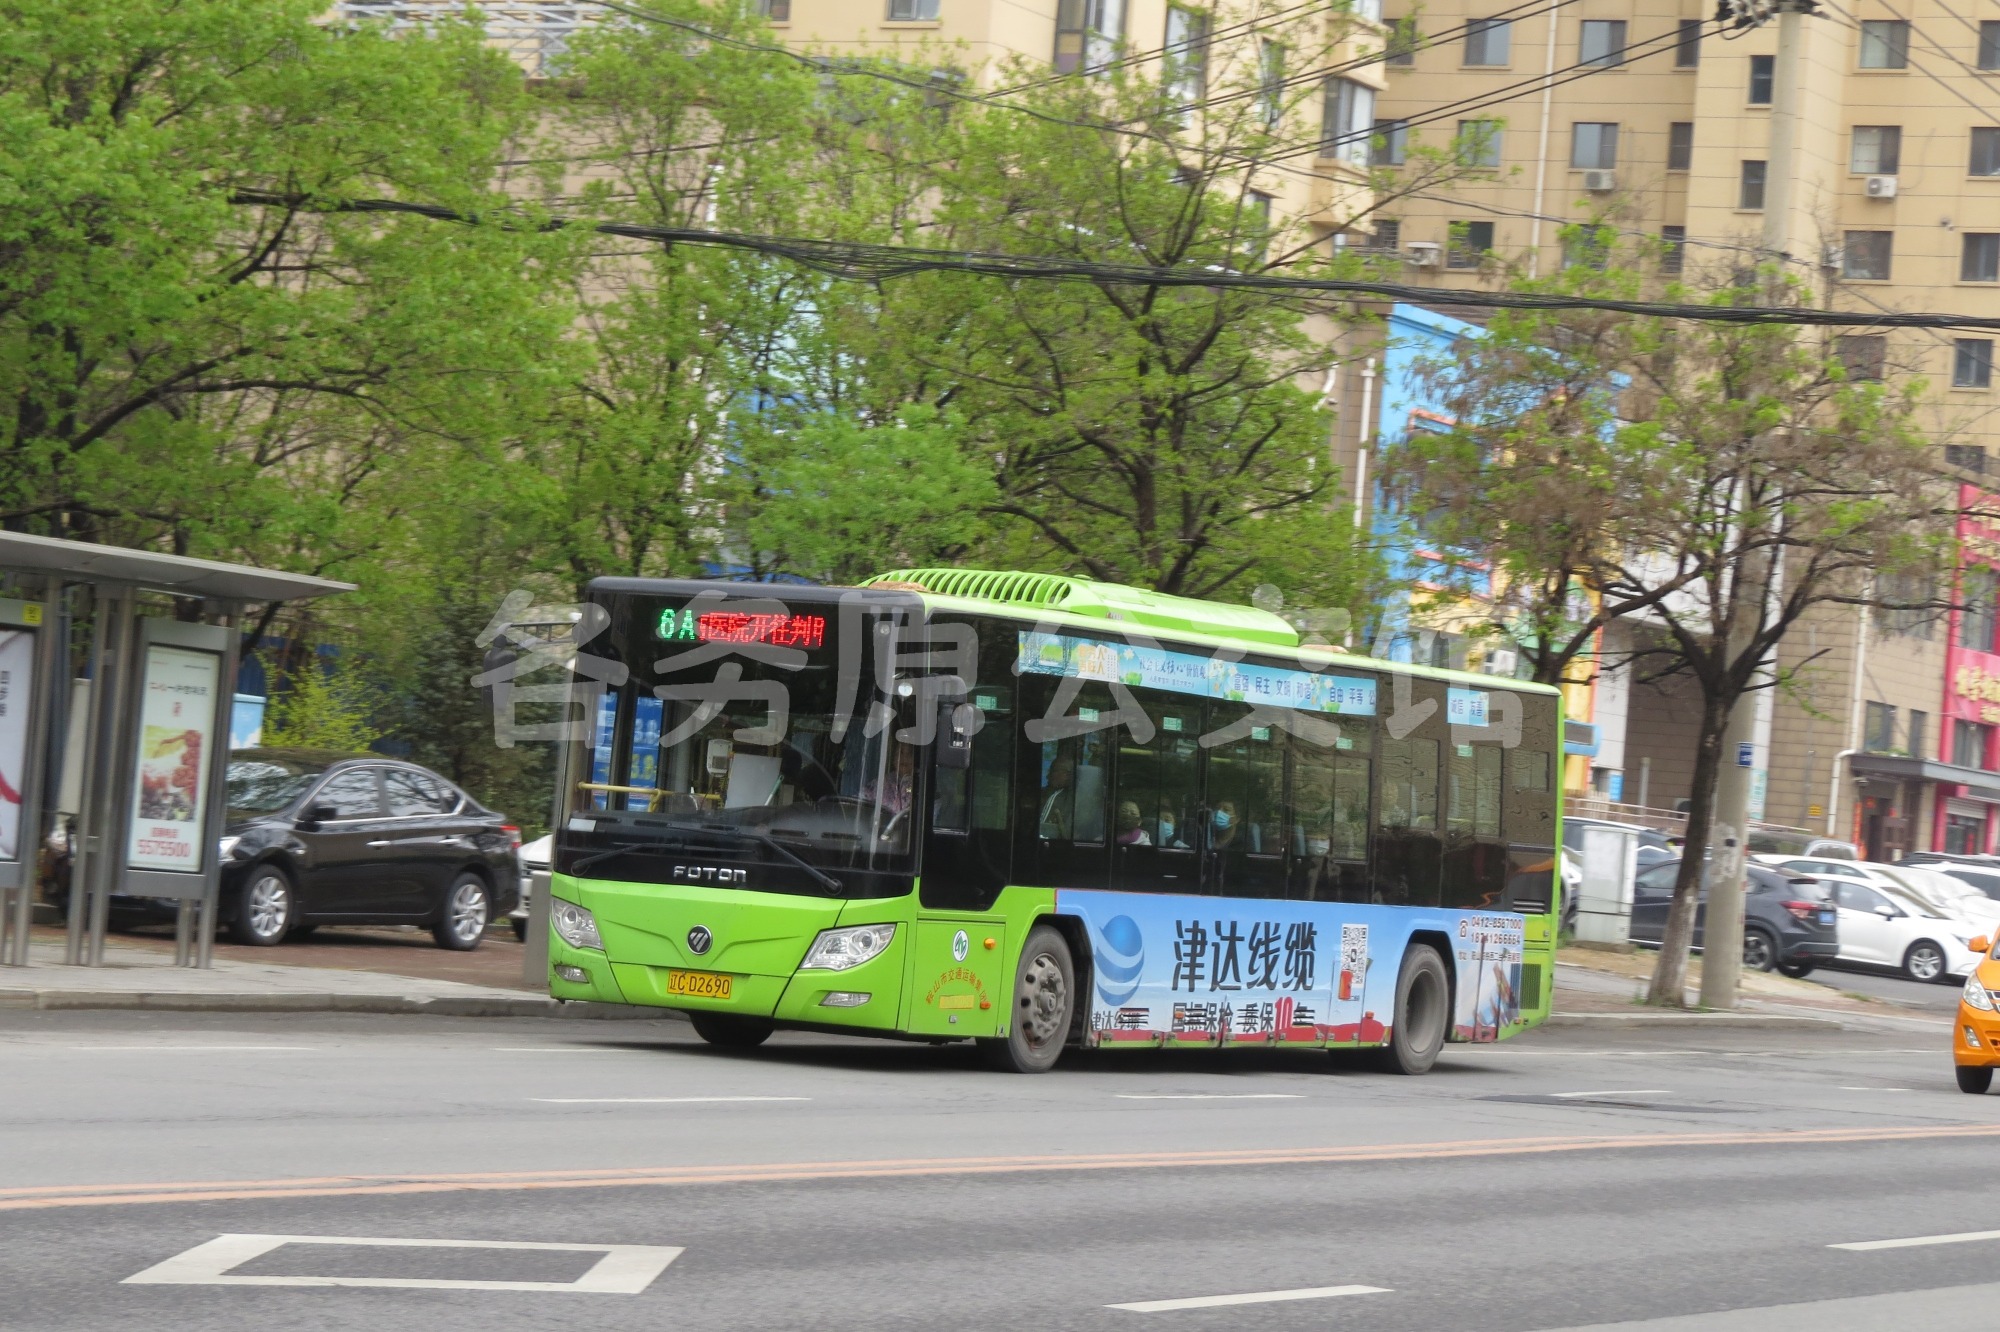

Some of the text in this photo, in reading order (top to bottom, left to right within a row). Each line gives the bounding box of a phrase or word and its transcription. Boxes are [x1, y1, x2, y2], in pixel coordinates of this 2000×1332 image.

[660, 609, 696, 640] 6A
[1234, 673, 1249, 692] 富强
[1255, 677, 1270, 695] 民主
[1276, 680, 1291, 697] 文明
[1330, 687, 1344, 704] 自由
[1349, 688, 1364, 705] 平等
[673, 865, 747, 882] FOTON
[1172, 919, 1318, 992] 津达线缆
